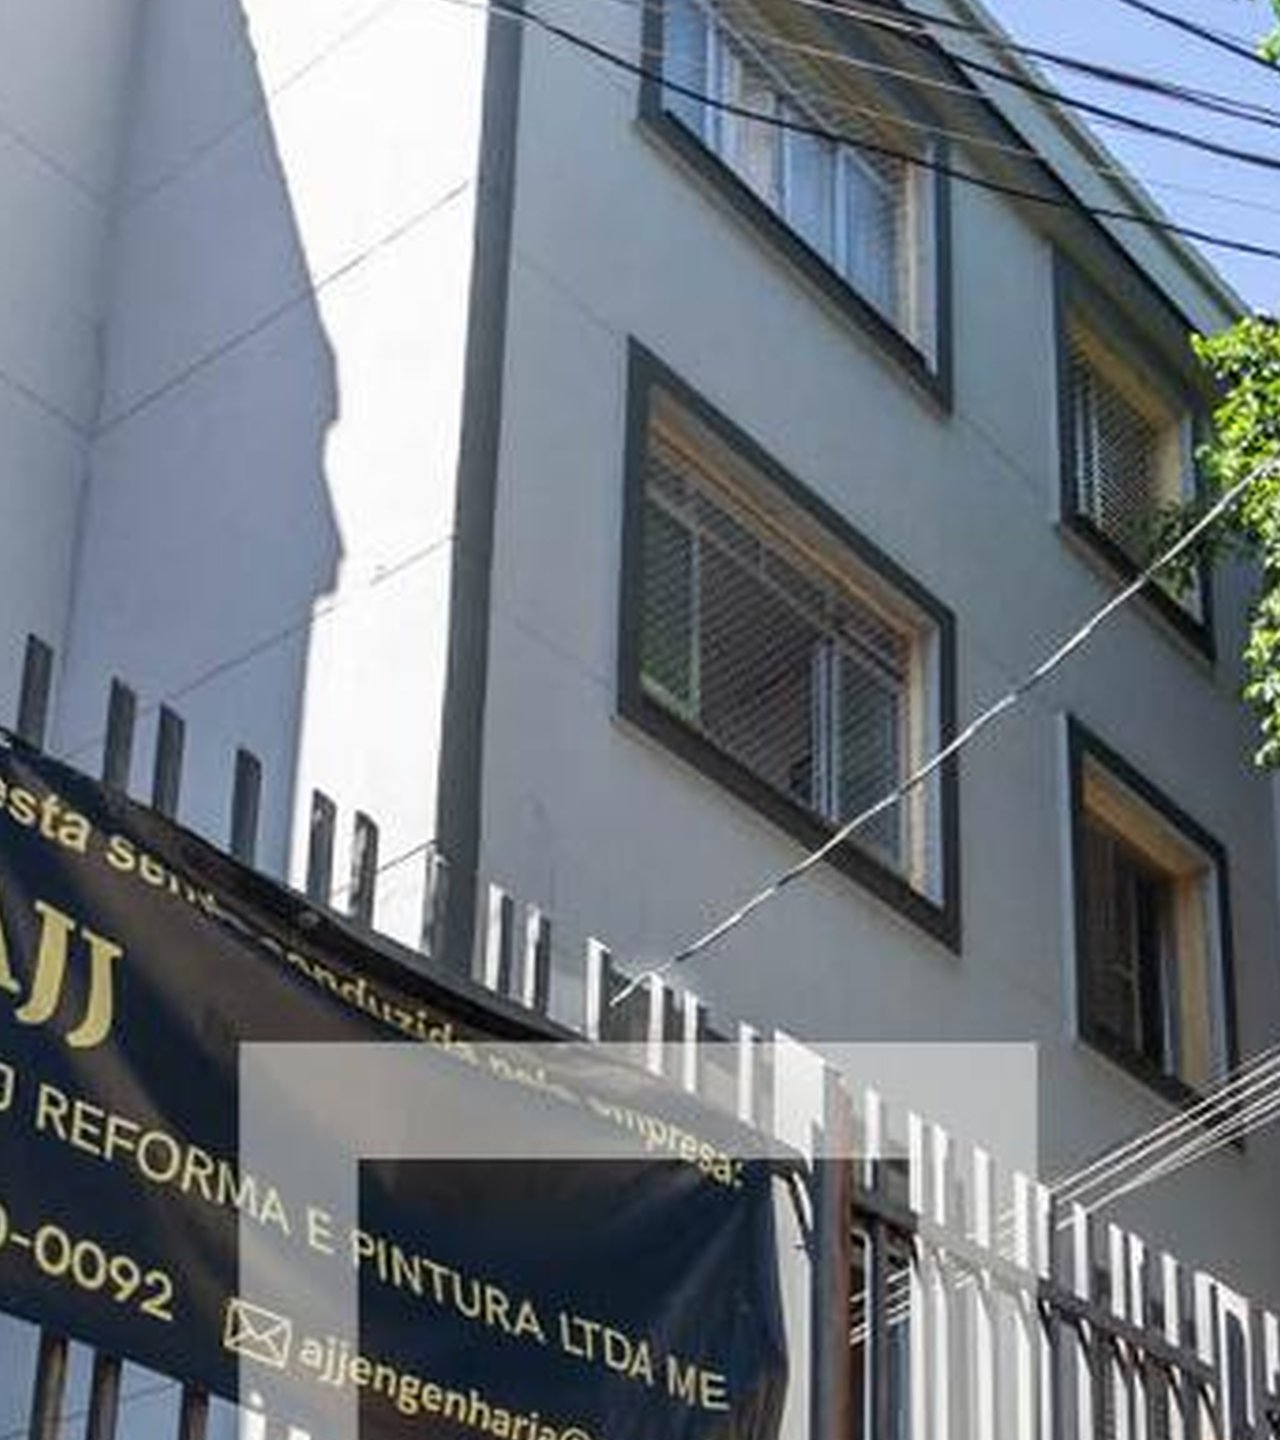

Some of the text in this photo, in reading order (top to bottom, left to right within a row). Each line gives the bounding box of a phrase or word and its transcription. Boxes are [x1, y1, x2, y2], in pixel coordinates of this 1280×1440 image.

[35, 1082, 292, 1239] REFORMA
[306, 1207, 335, 1256] E
[352, 1227, 548, 1345] PINTURA
[559, 1311, 655, 1388] LTDA
[667, 1355, 731, 1413] ME
